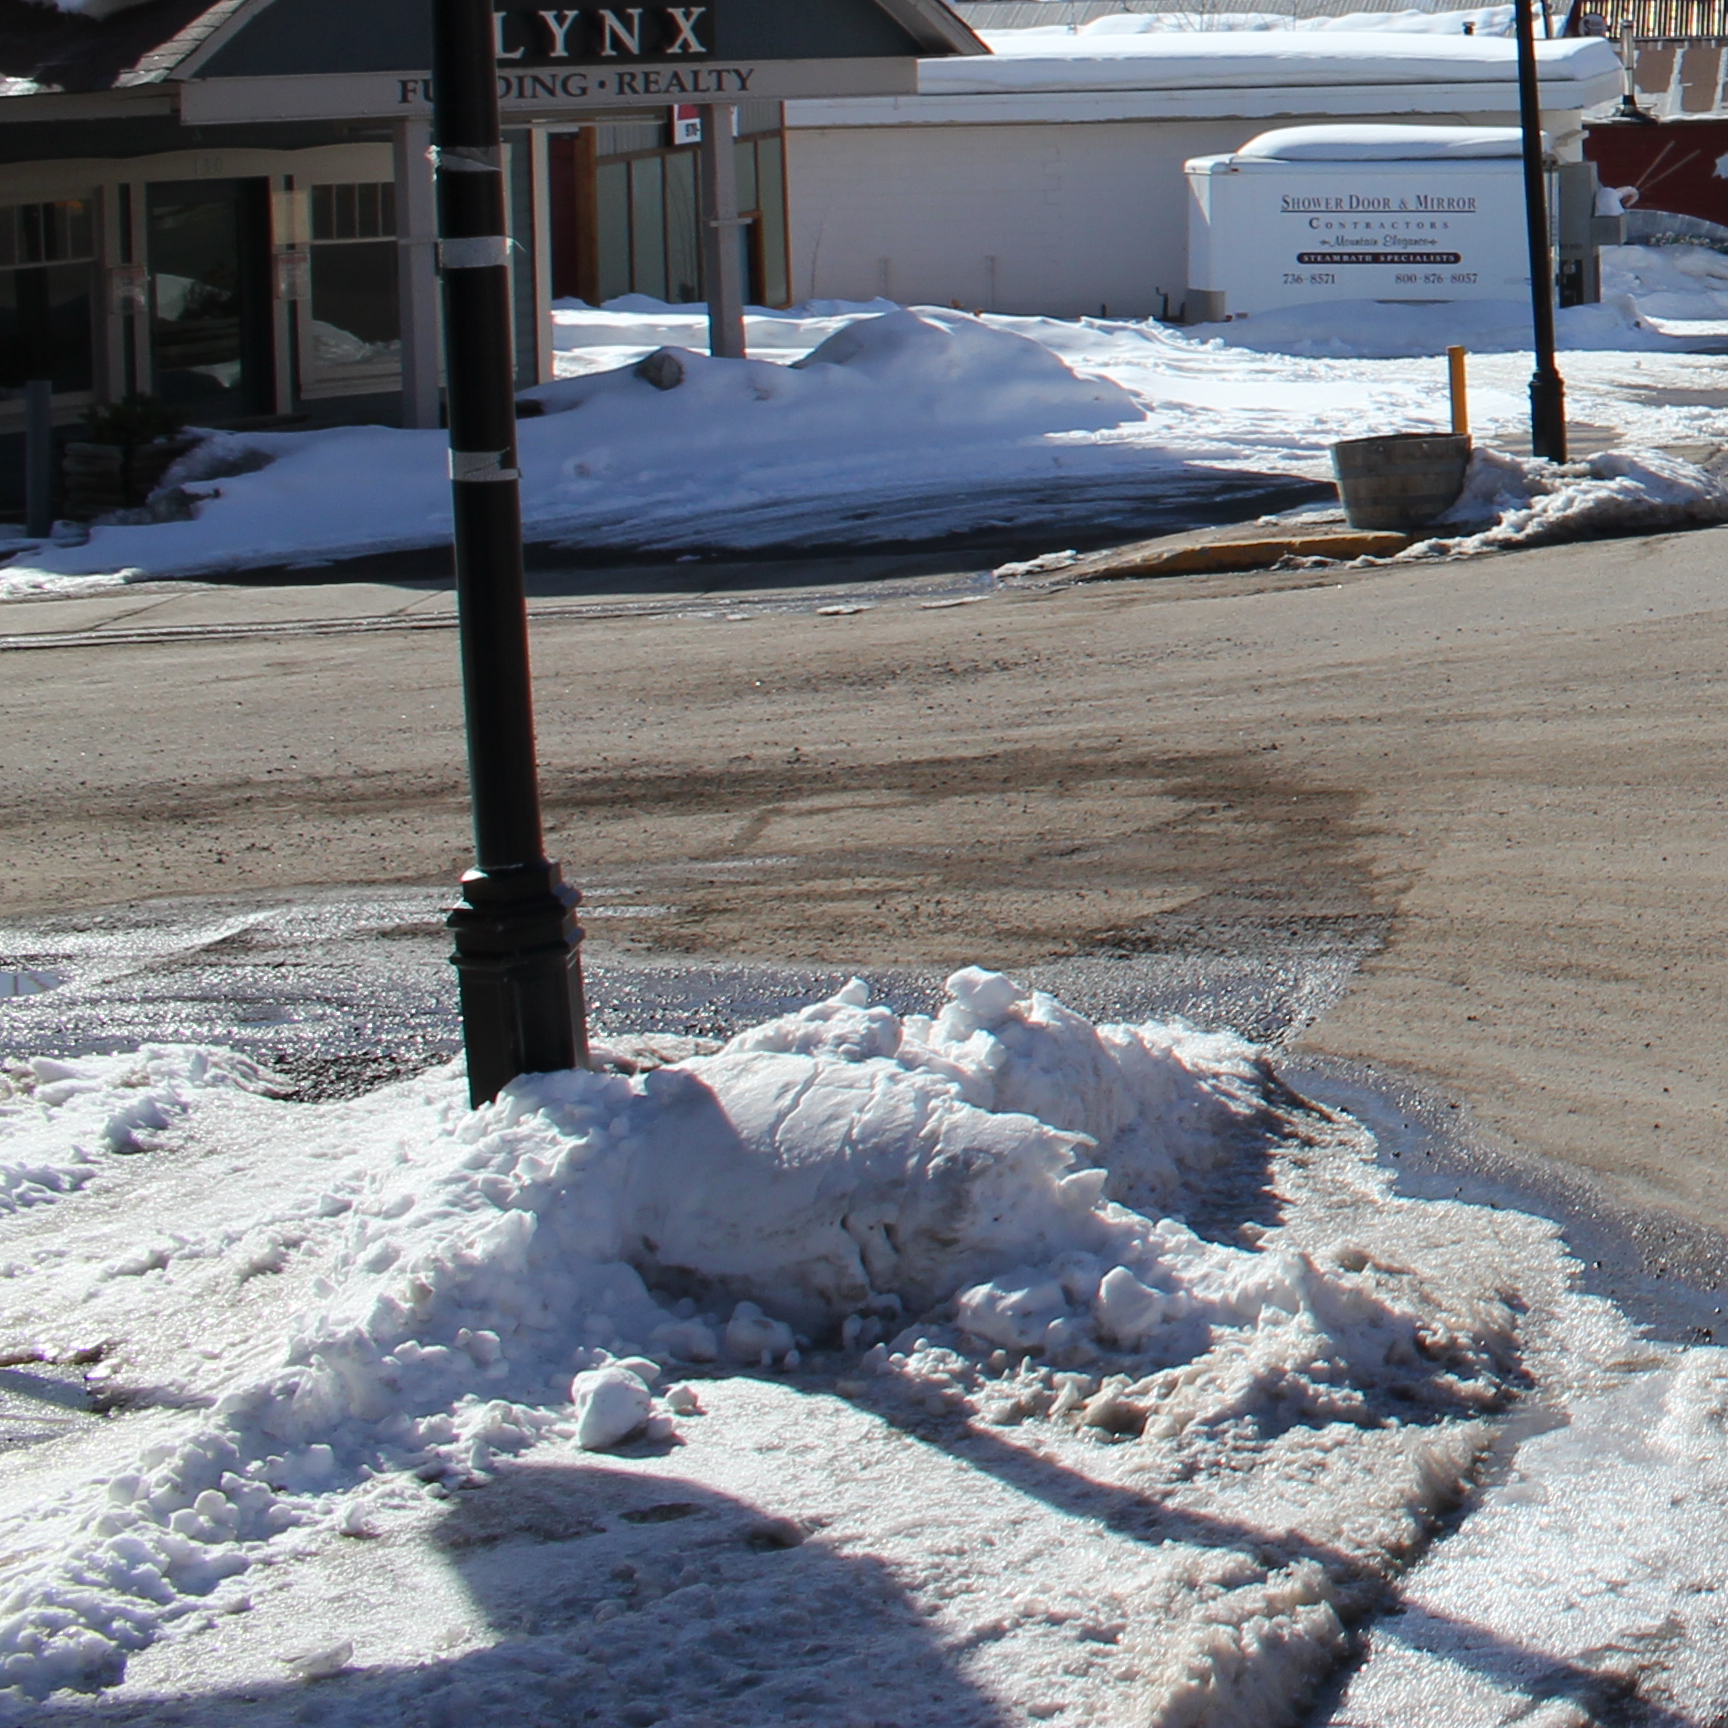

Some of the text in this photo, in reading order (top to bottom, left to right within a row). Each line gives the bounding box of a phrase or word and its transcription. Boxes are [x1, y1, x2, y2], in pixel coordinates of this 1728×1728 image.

[493, 7, 707, 59] LYNX
[398, 68, 755, 104] FUDING REALTY
[1281, 194, 1477, 211] SHOWER DOOR & MIRROR
[1308, 217, 1450, 229] CONTRACTORS
[1331, 234, 1428, 249] Mountain Elegance
[1302, 254, 1455, 262] STEAMBATH SPECIALISTS
